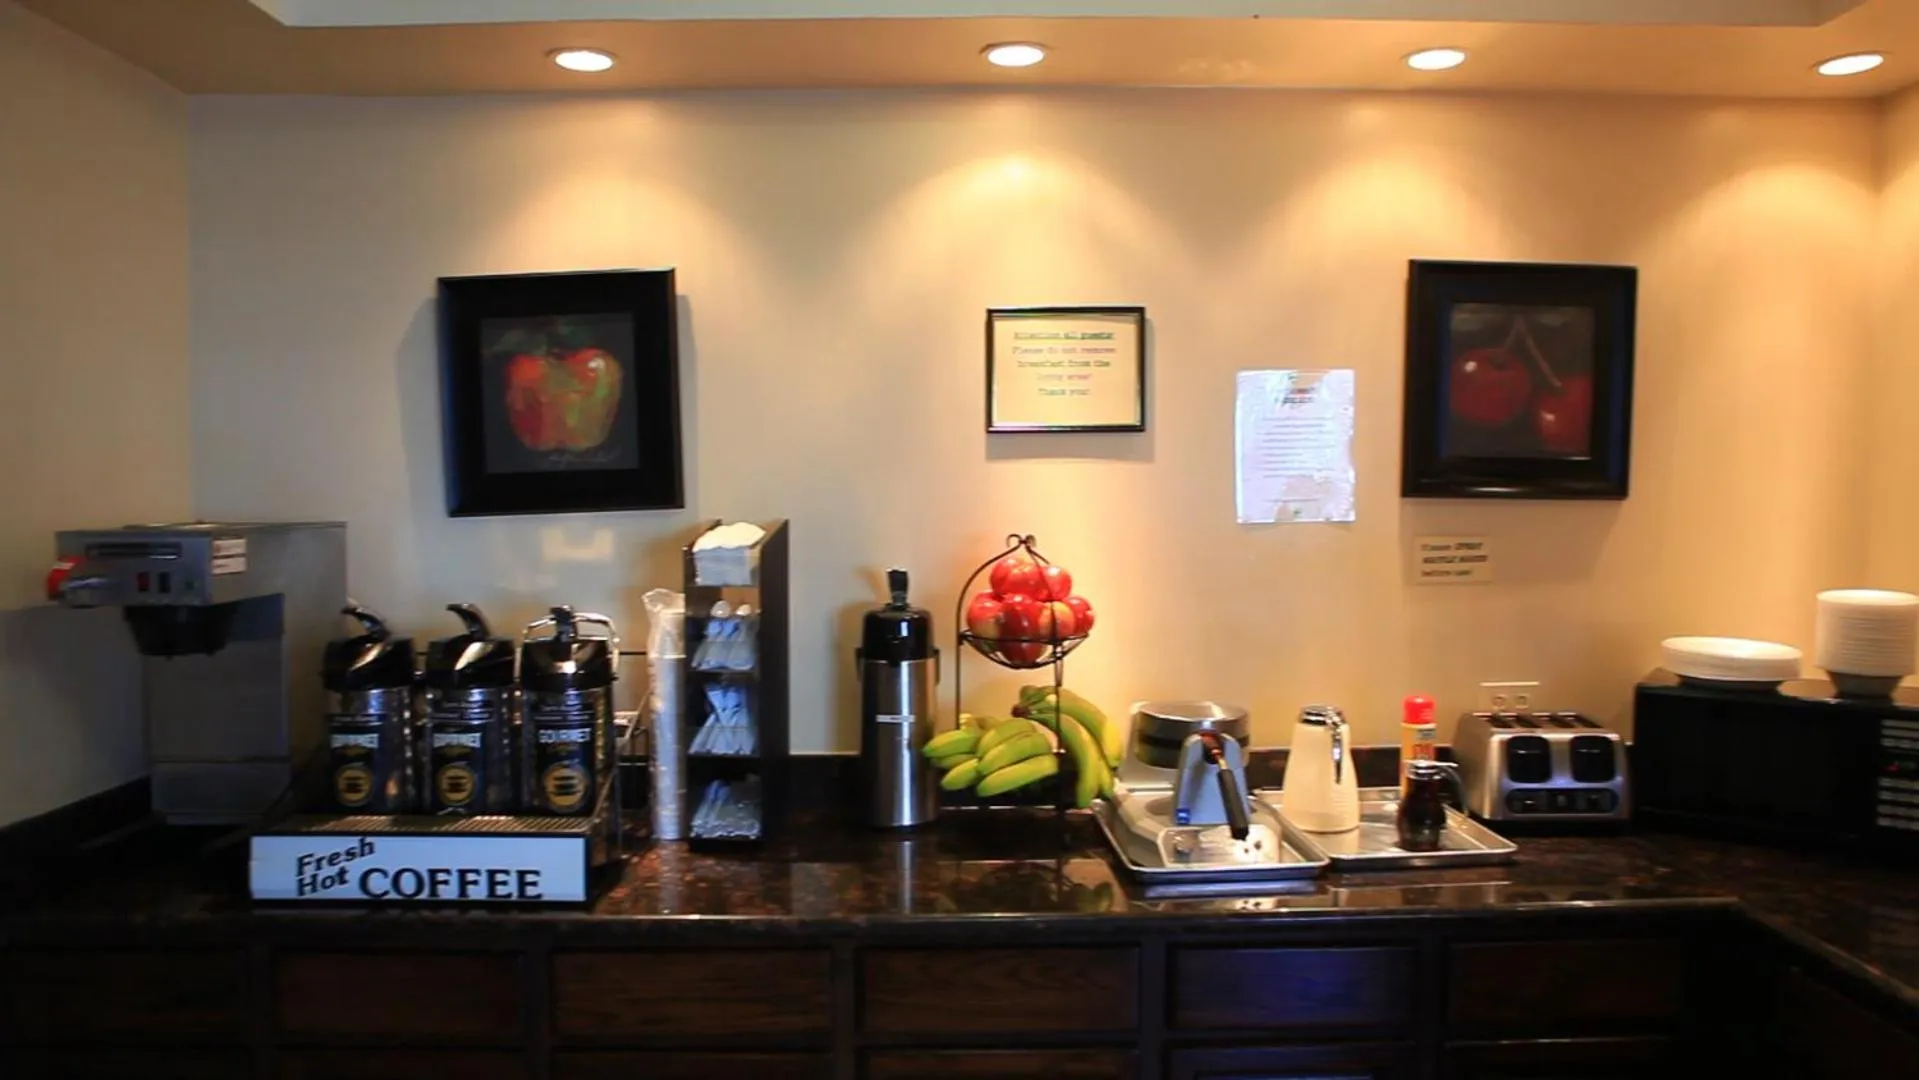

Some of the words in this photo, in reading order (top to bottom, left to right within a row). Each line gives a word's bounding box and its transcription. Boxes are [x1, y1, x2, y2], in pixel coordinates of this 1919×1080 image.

[295, 836, 376, 877] Fresh
[295, 866, 349, 897] Hot
[358, 867, 543, 899] COFFEE
